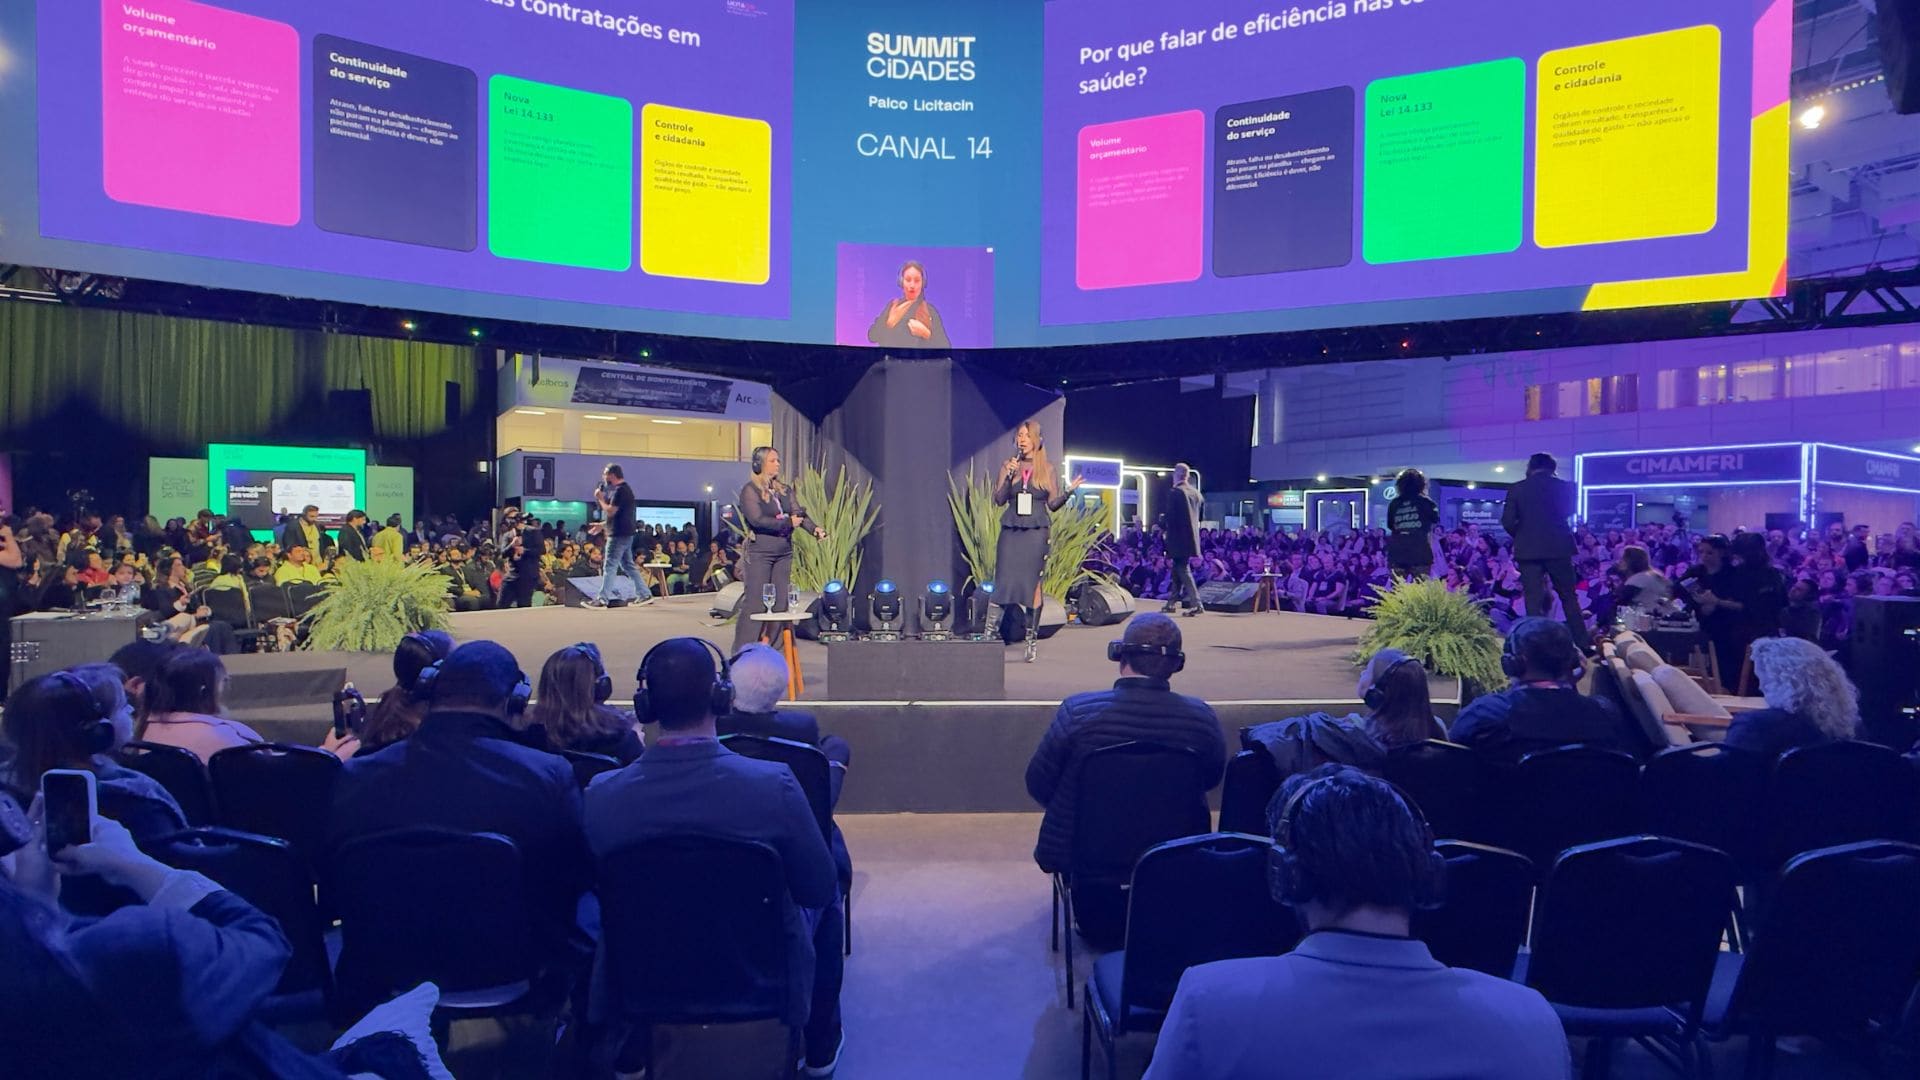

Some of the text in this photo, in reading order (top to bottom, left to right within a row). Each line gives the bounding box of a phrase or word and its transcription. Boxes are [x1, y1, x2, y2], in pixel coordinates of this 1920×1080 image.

[122, 4, 176, 26] Volume
[521, 0, 663, 40] contratações
[668, 27, 701, 48] em
[123, 22, 217, 50] orçamentário
[1079, 0, 1394, 65] Por que falar de eficiência nas
[330, 52, 408, 79] Continuidade
[1554, 60, 1606, 76] Controle
[330, 67, 391, 89] do serviço
[1078, 66, 1149, 95] saúde?
[1554, 73, 1622, 91] e cidadania
[504, 91, 530, 104] Nova
[868, 96, 974, 112] Palco Licitacin
[1381, 93, 1407, 104] Nova
[1581, 108, 1591, 116] de
[1593, 102, 1625, 115] controle
[1634, 96, 1674, 109] sociedade
[330, 98, 452, 130] Atraso, falha ou desabastecimento
[504, 105, 554, 121] Lei 14.133
[1226, 110, 1291, 128] Continuidade
[1380, 102, 1433, 118] Lei 14.133
[1623, 105, 1677, 120] transparência
[330, 108, 345, 118] não
[346, 112, 370, 124] param
[382, 118, 411, 131] planilha
[420, 125, 448, 140] chegam
[449, 132, 459, 140] ao
[655, 119, 694, 133] Controle
[1591, 125, 1601, 133] do
[1603, 122, 1625, 134] gasto
[1637, 118, 1652, 128] não
[1654, 116, 1682, 128] apenas
[366, 122, 400, 138] Eficiência
[401, 129, 406, 138] é
[429, 136, 444, 145] não
[662, 133, 706, 147] cidadania
[1090, 137, 1122, 148] Volume
[1226, 127, 1276, 141] do serviço
[857, 133, 993, 160] CANAL 14
[1089, 145, 1148, 160] orçamentário
[1553, 138, 1578, 149] menor
[601, 372, 634, 381] CENTRAL
[1626, 454, 1744, 475] CIMAMFRI
[1866, 459, 1899, 477] CIMAMFRI
